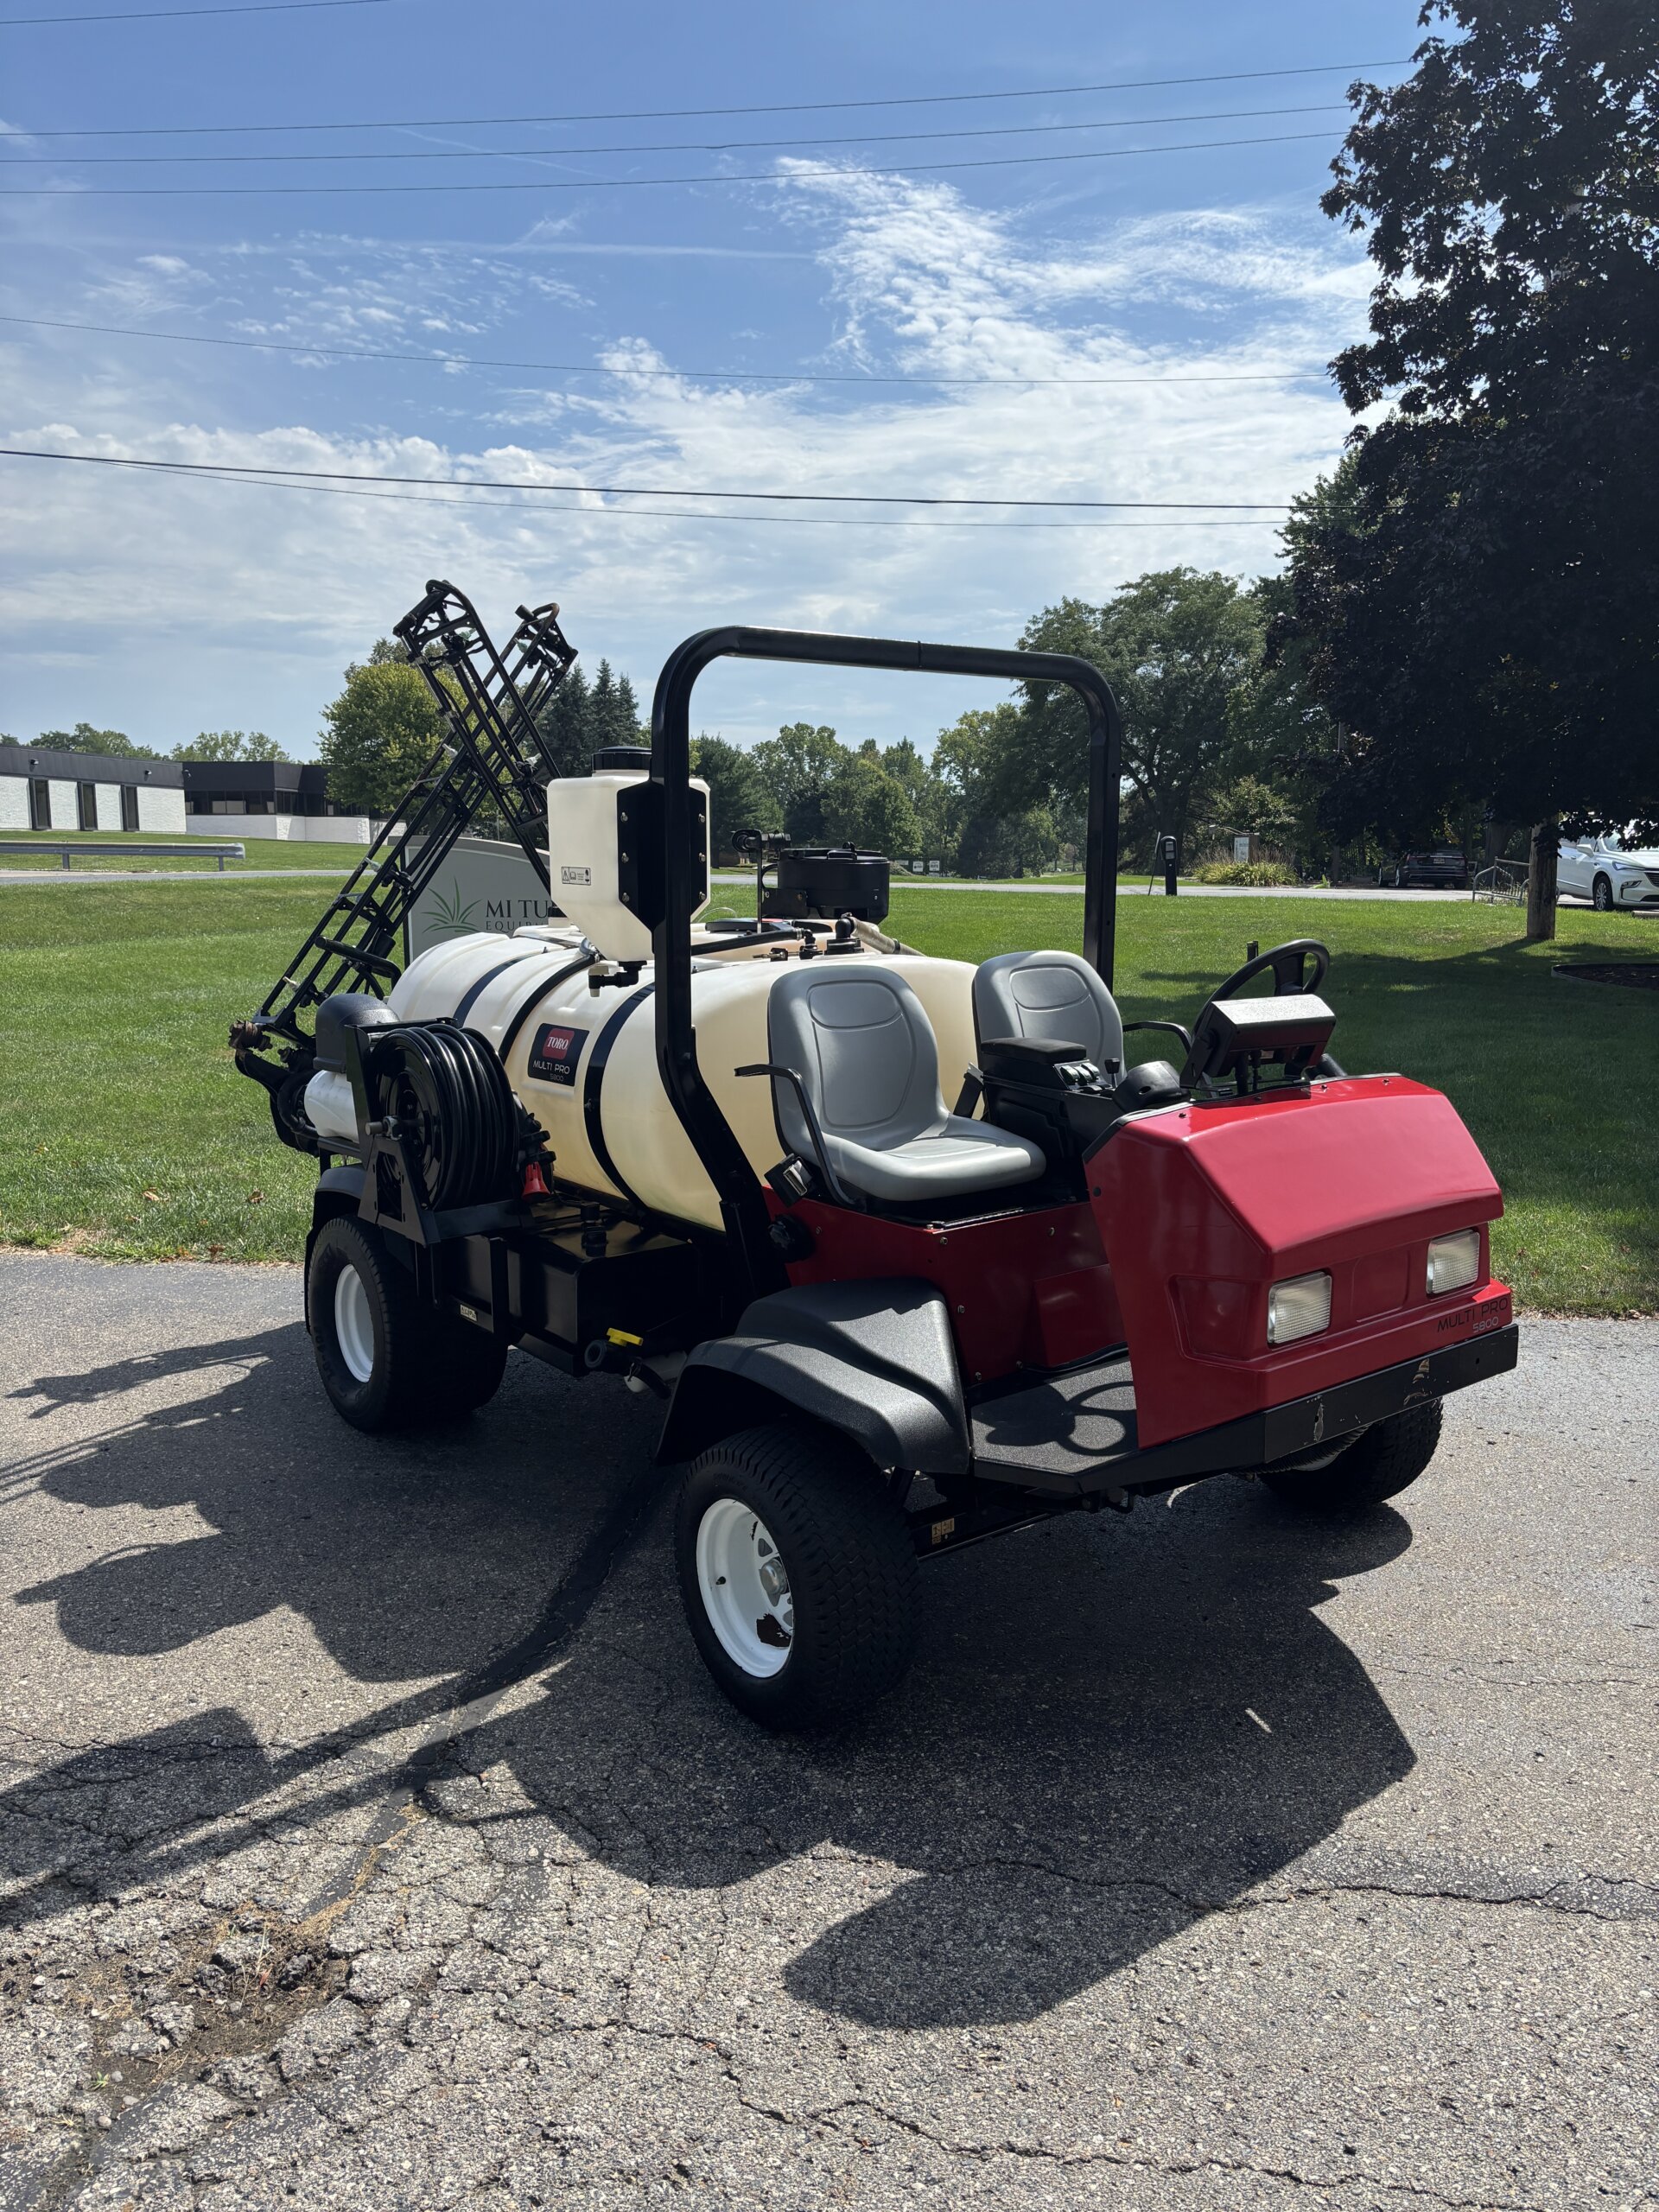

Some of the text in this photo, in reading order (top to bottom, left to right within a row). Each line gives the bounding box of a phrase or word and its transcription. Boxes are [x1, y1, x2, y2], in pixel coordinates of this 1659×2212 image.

[486, 899, 512, 918] MI
[486, 920, 544, 933] EQUI
[547, 1036, 569, 1050] TORO
[532, 1059, 570, 1075] MULTI PRO
[1437, 1297, 1508, 1333] MULTI PRO
[1472, 1316, 1499, 1333] 5800
